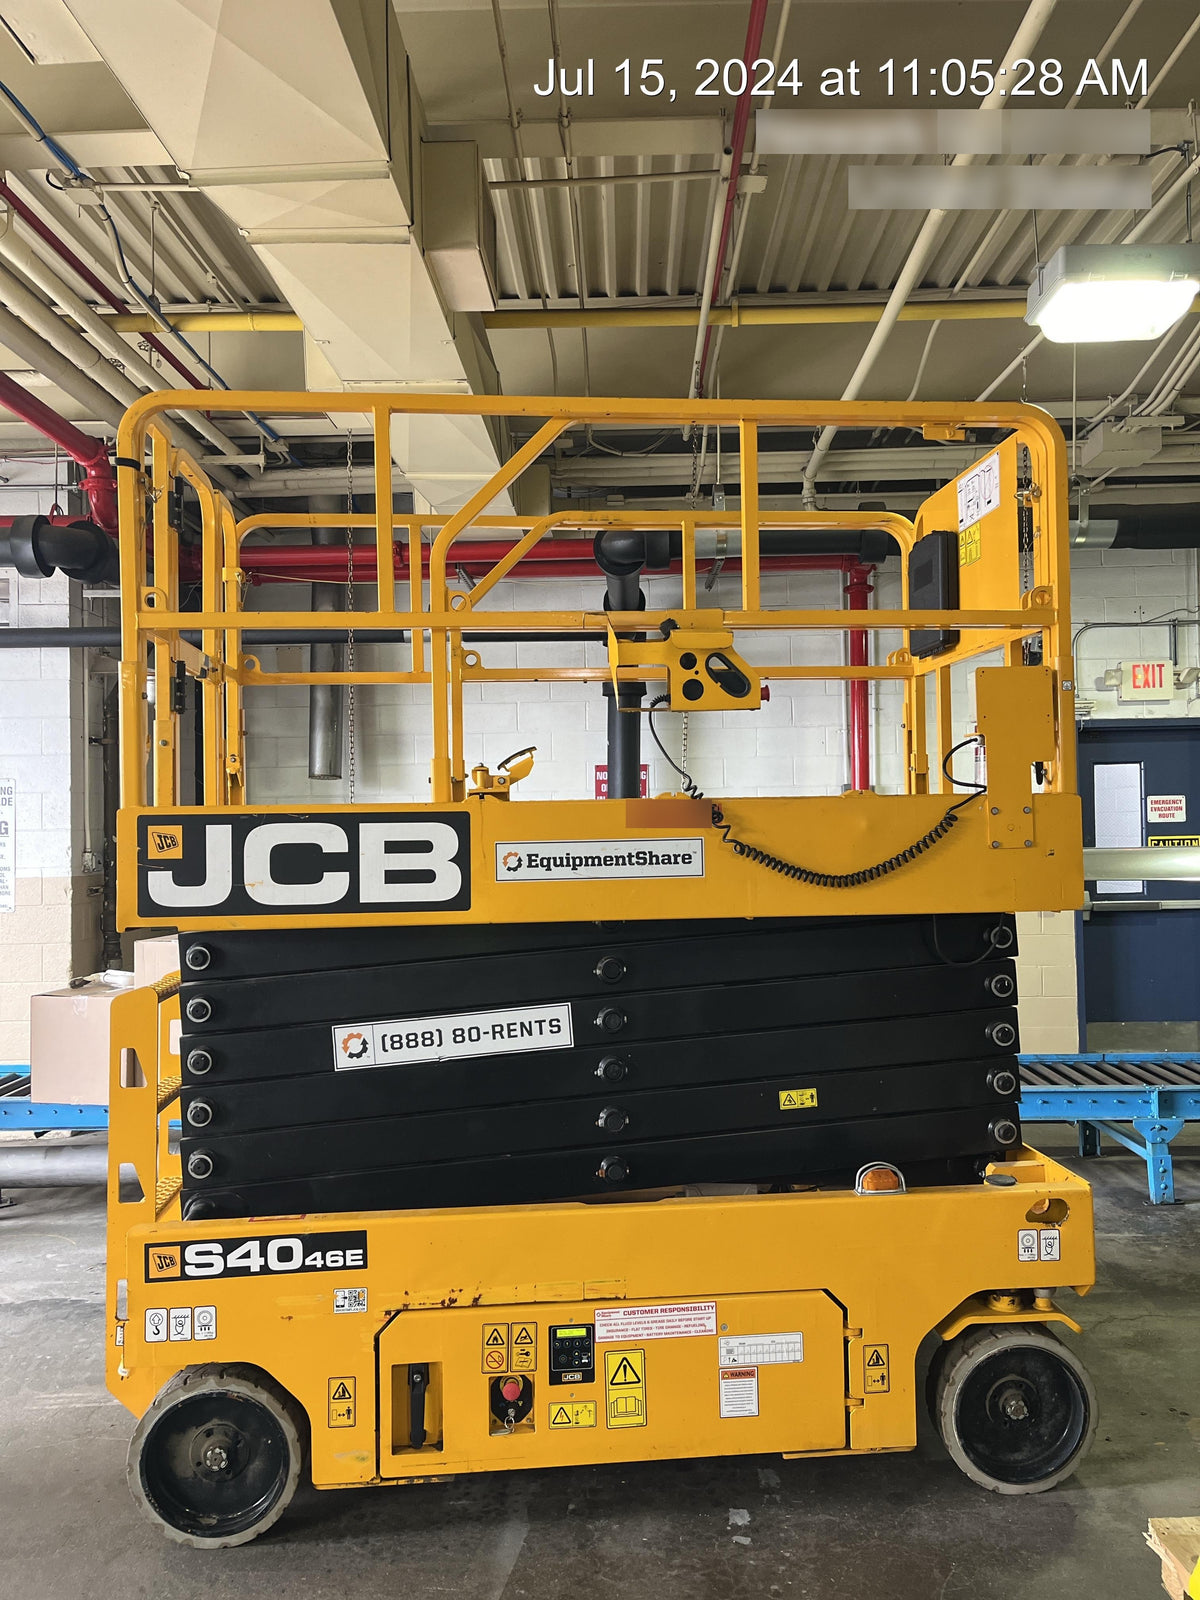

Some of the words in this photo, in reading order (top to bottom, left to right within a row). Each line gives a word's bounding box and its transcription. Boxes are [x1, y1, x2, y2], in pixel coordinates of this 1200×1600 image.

[1132, 664, 1165, 689] EXIT
[157, 834, 177, 849] JCB
[148, 822, 462, 907] JCB
[381, 1028, 443, 1052] (888)
[452, 1018, 562, 1044] 80-RENTS
[157, 1254, 176, 1270] JCB
[623, 1307, 659, 1316] CUSTOMER
[660, 1304, 715, 1314] RESPONSIBILITY
